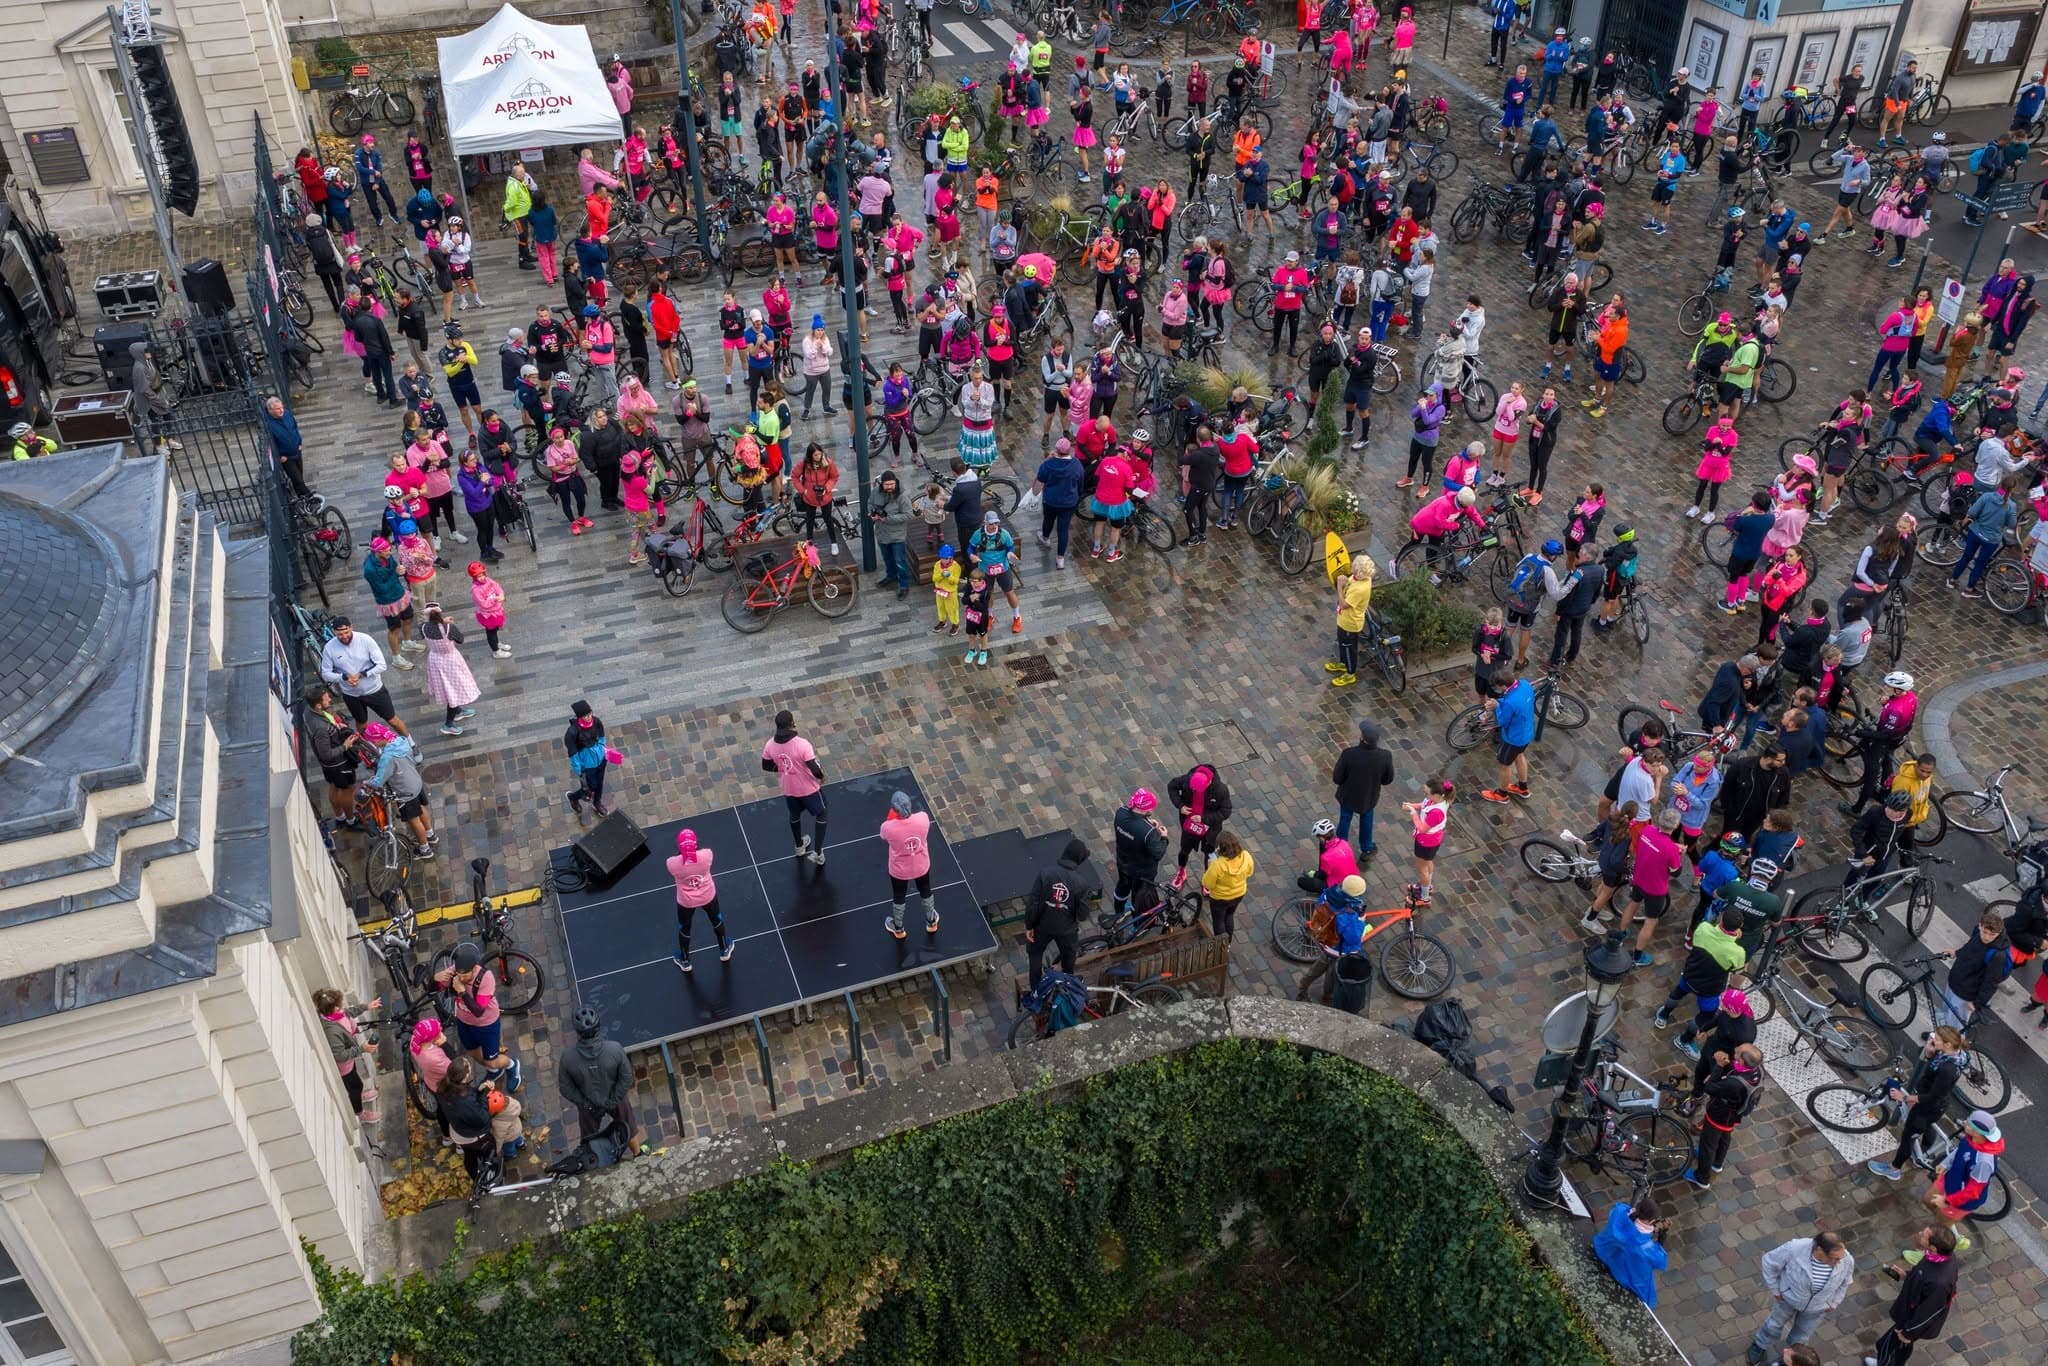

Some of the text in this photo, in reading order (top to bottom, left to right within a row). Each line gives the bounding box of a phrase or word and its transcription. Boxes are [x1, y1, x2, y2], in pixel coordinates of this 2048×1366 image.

[495, 95, 572, 114] ARPAJON
[536, 108, 547, 117] de
[549, 107, 561, 115] vie
